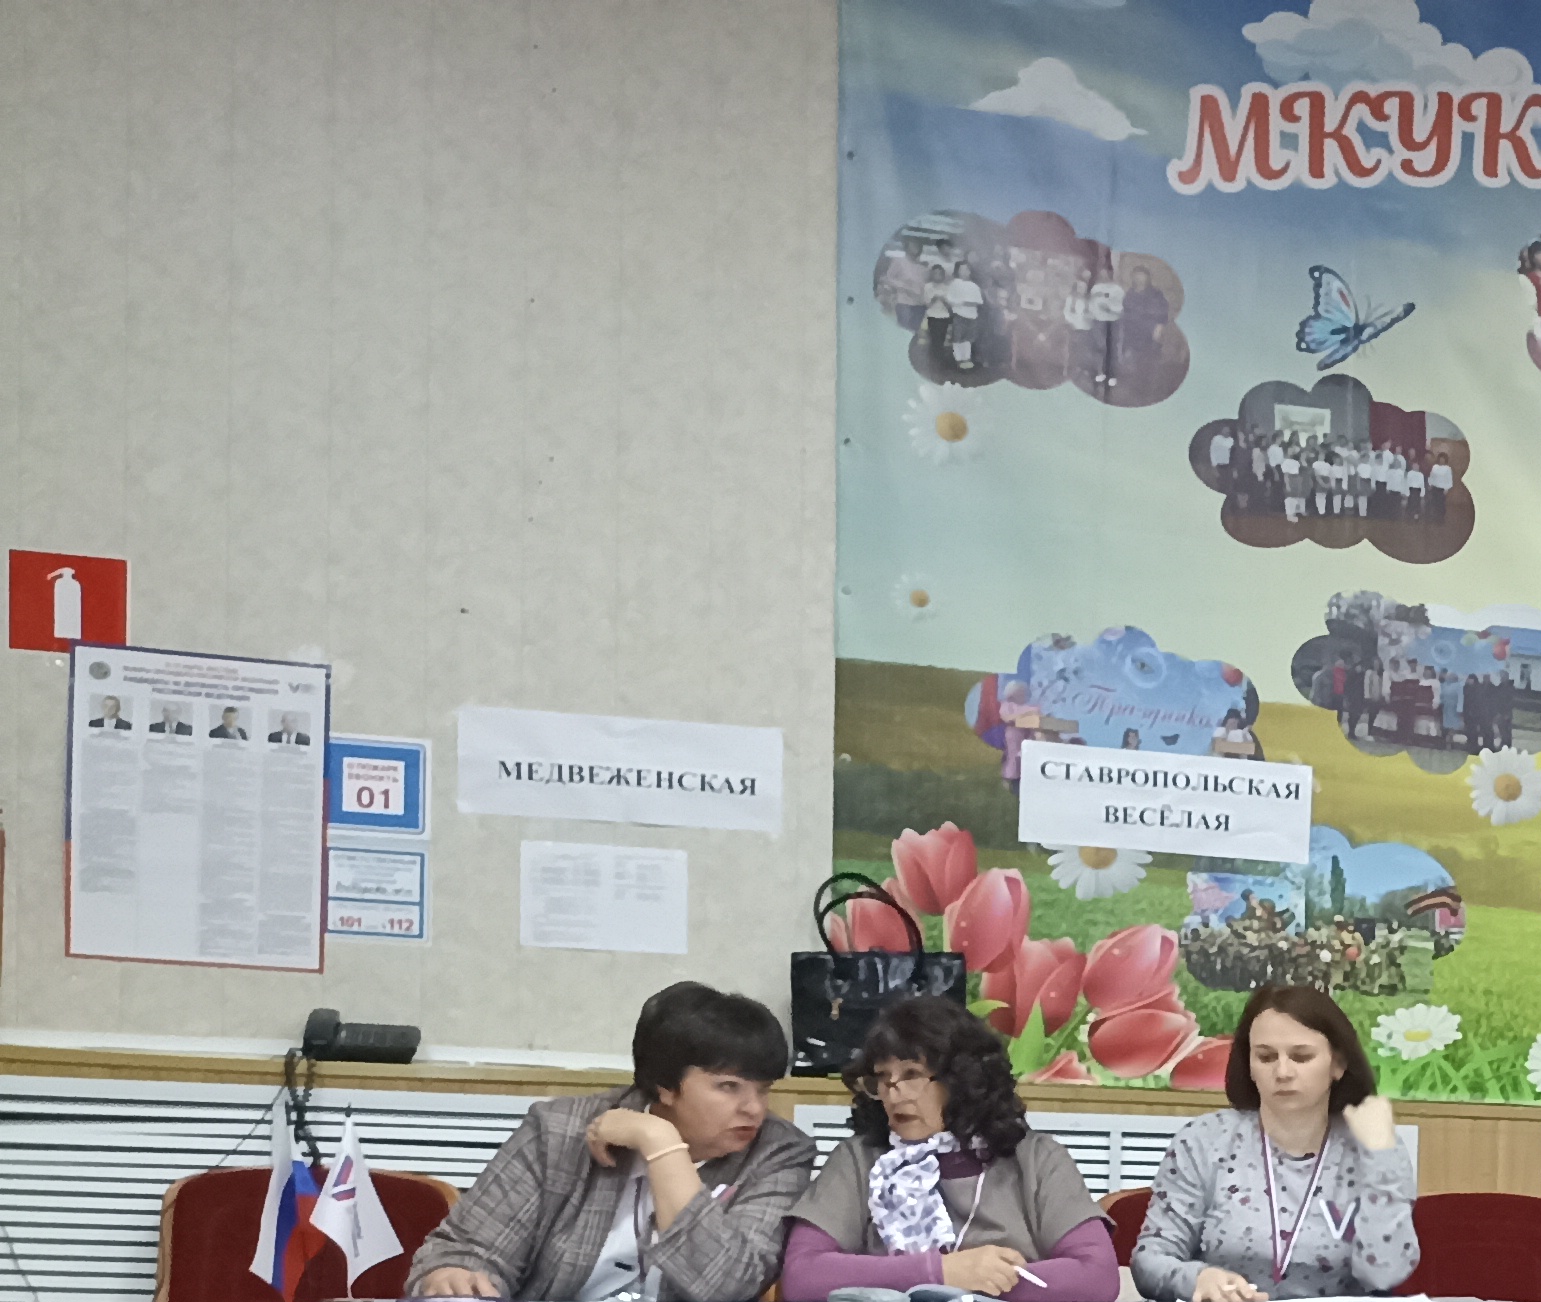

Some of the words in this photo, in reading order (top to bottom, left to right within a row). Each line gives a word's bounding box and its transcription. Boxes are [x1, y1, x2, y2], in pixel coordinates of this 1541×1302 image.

[498, 760, 758, 797] МЕДВЕЖЕНСКАЯ
[1040, 760, 1301, 801] СТАВРОПОЛЬСКАЯ
[356, 786, 390, 810] 01
[1103, 803, 1231, 832] ВЕСЁЛАЯ
[387, 917, 415, 933] 112
